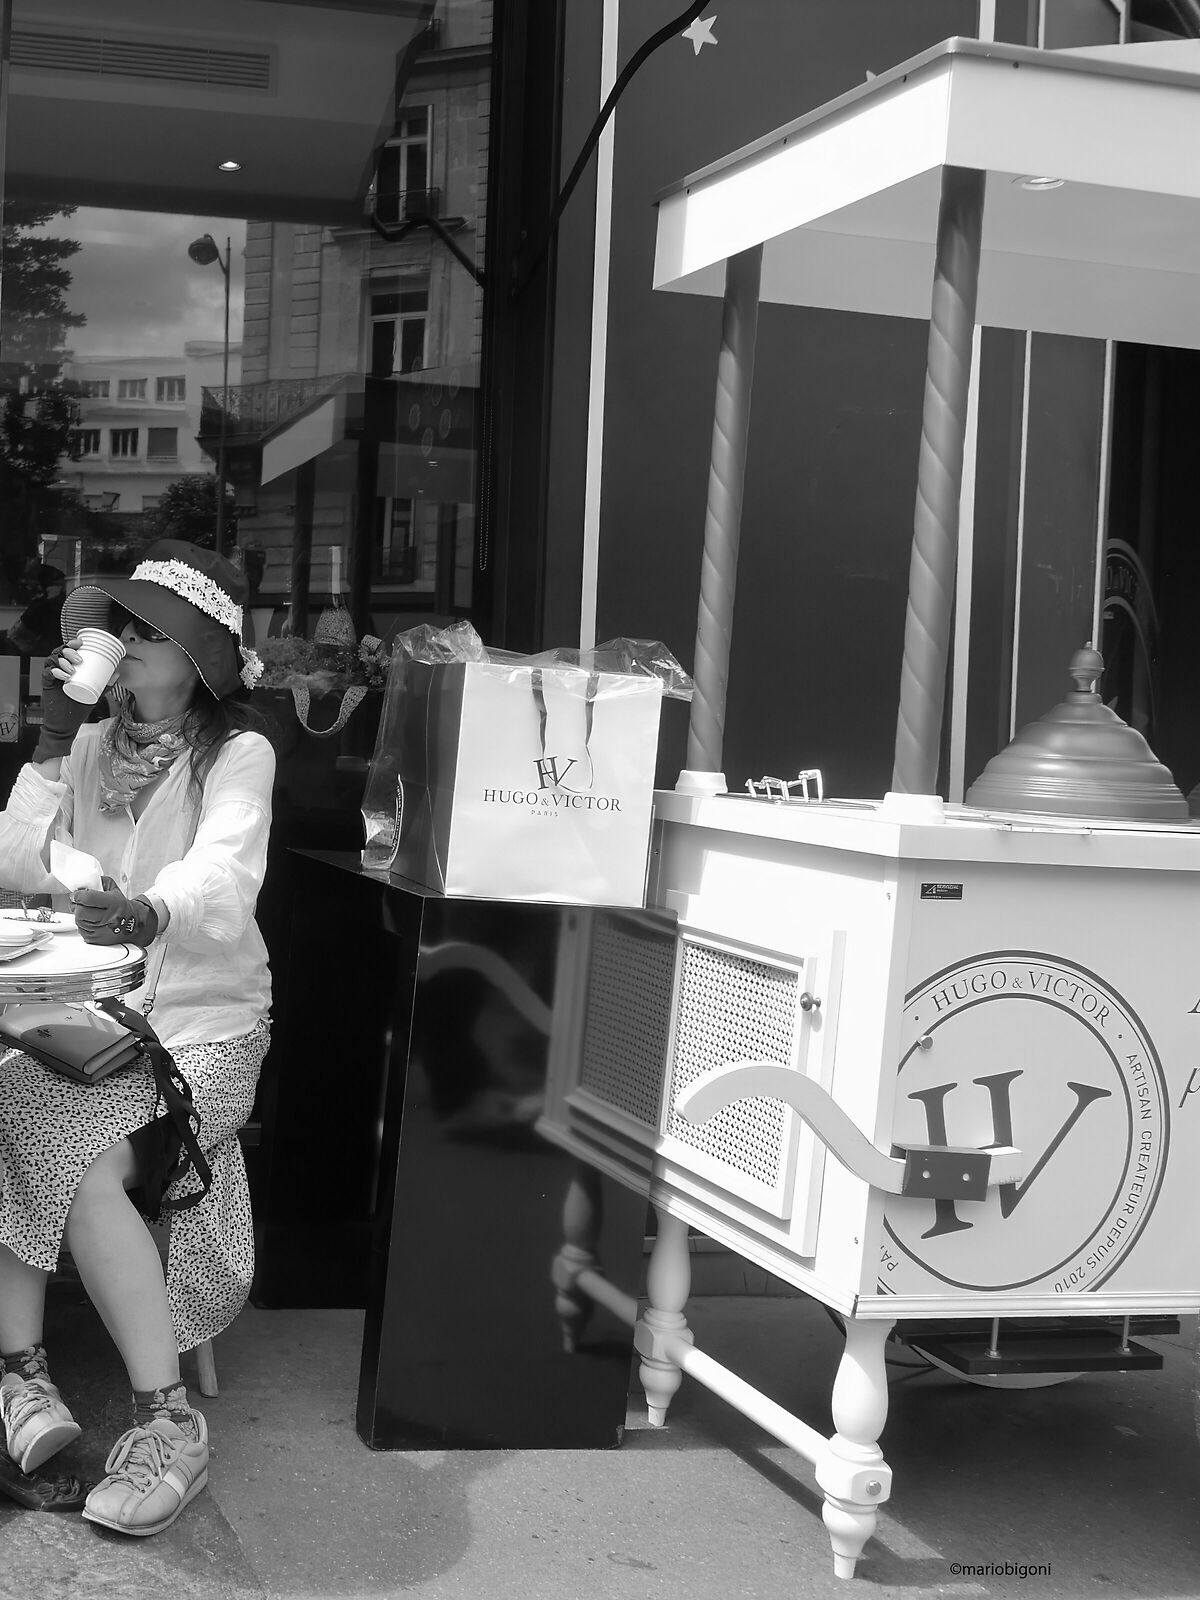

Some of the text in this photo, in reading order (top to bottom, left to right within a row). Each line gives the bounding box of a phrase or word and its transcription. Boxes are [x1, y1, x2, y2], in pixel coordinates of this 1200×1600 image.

[533, 756, 578, 790] HV
[483, 788, 622, 812] HUGO & VICTOR
[931, 970, 1111, 1028] HUGO & VICTOR
[1054, 1053, 1152, 1293] ARTISAN CREATEUR DEPUIS 2010
